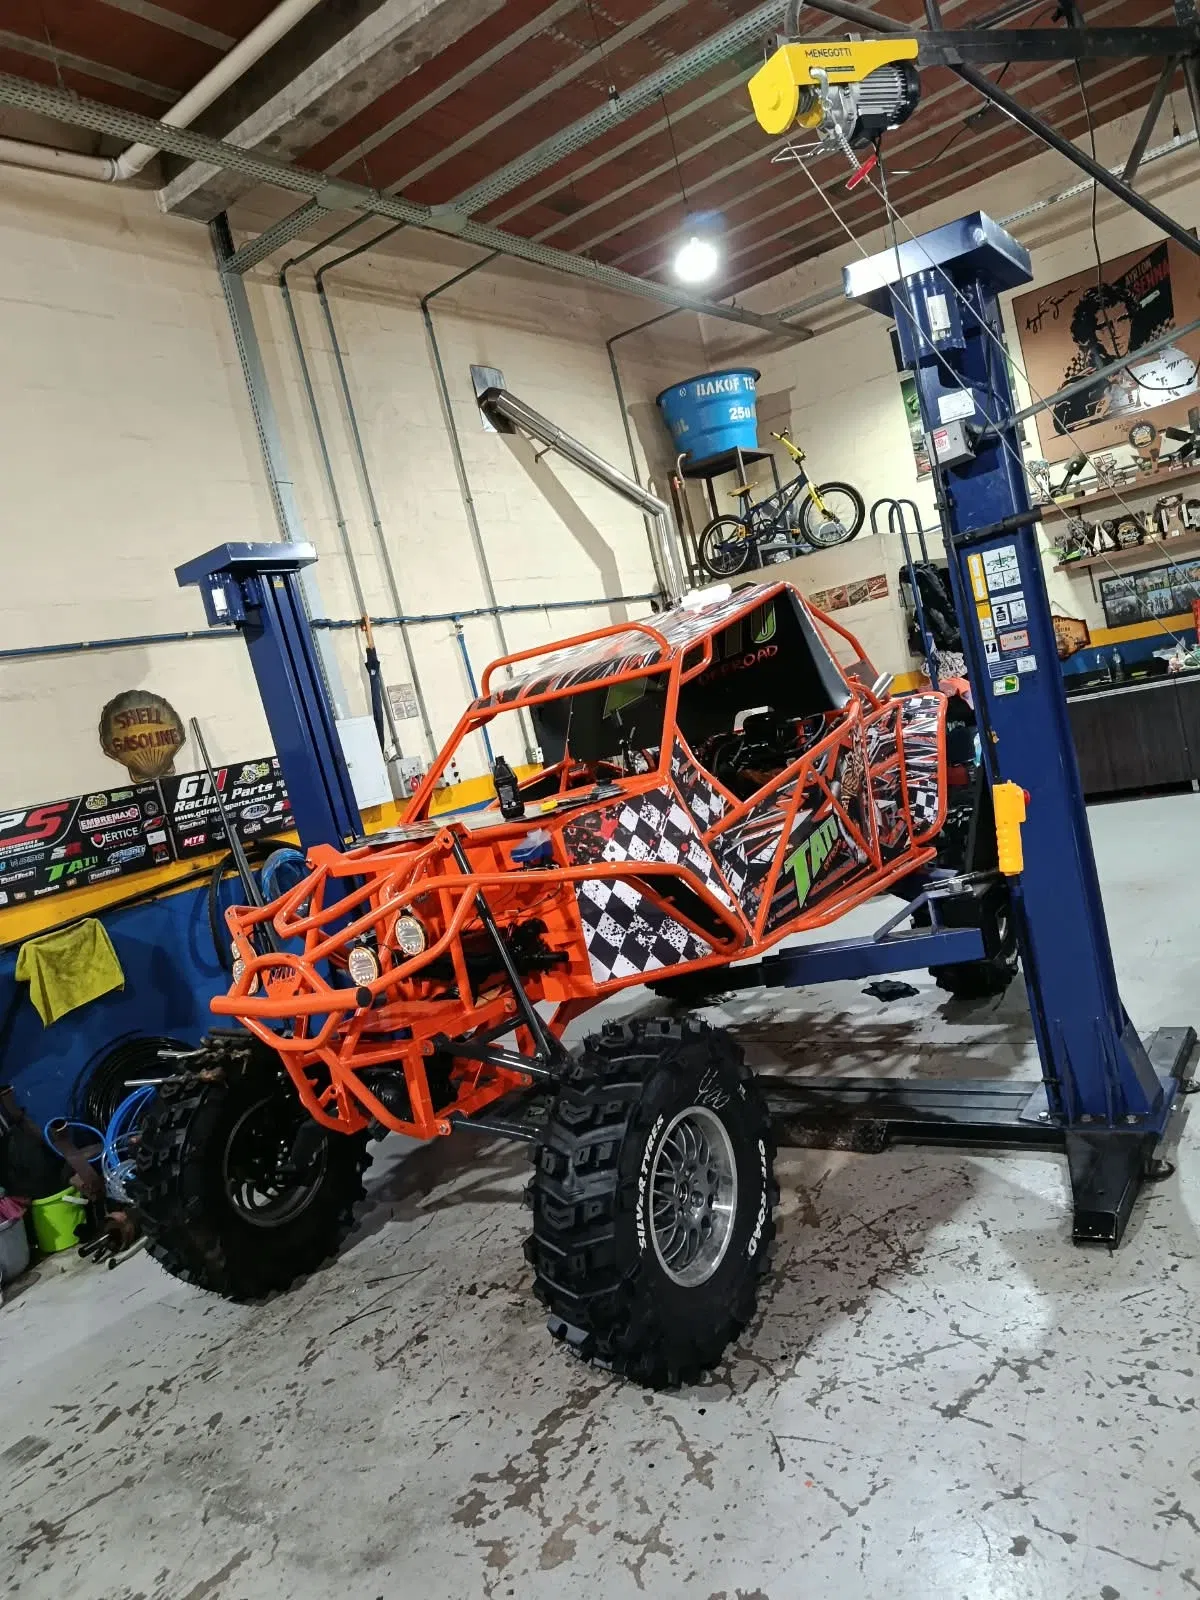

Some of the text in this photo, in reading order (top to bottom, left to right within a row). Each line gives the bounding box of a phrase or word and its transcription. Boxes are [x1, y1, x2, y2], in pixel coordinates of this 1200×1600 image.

[805, 47, 852, 57] MENEGOTTI
[177, 768, 228, 800] GTI
[231, 782, 274, 800] Parts
[80, 810, 132, 829] EMBREMAX
[44, 856, 98, 882] TATU
[784, 814, 839, 909] TATU
[636, 1114, 665, 1251] SILVER TYRES
